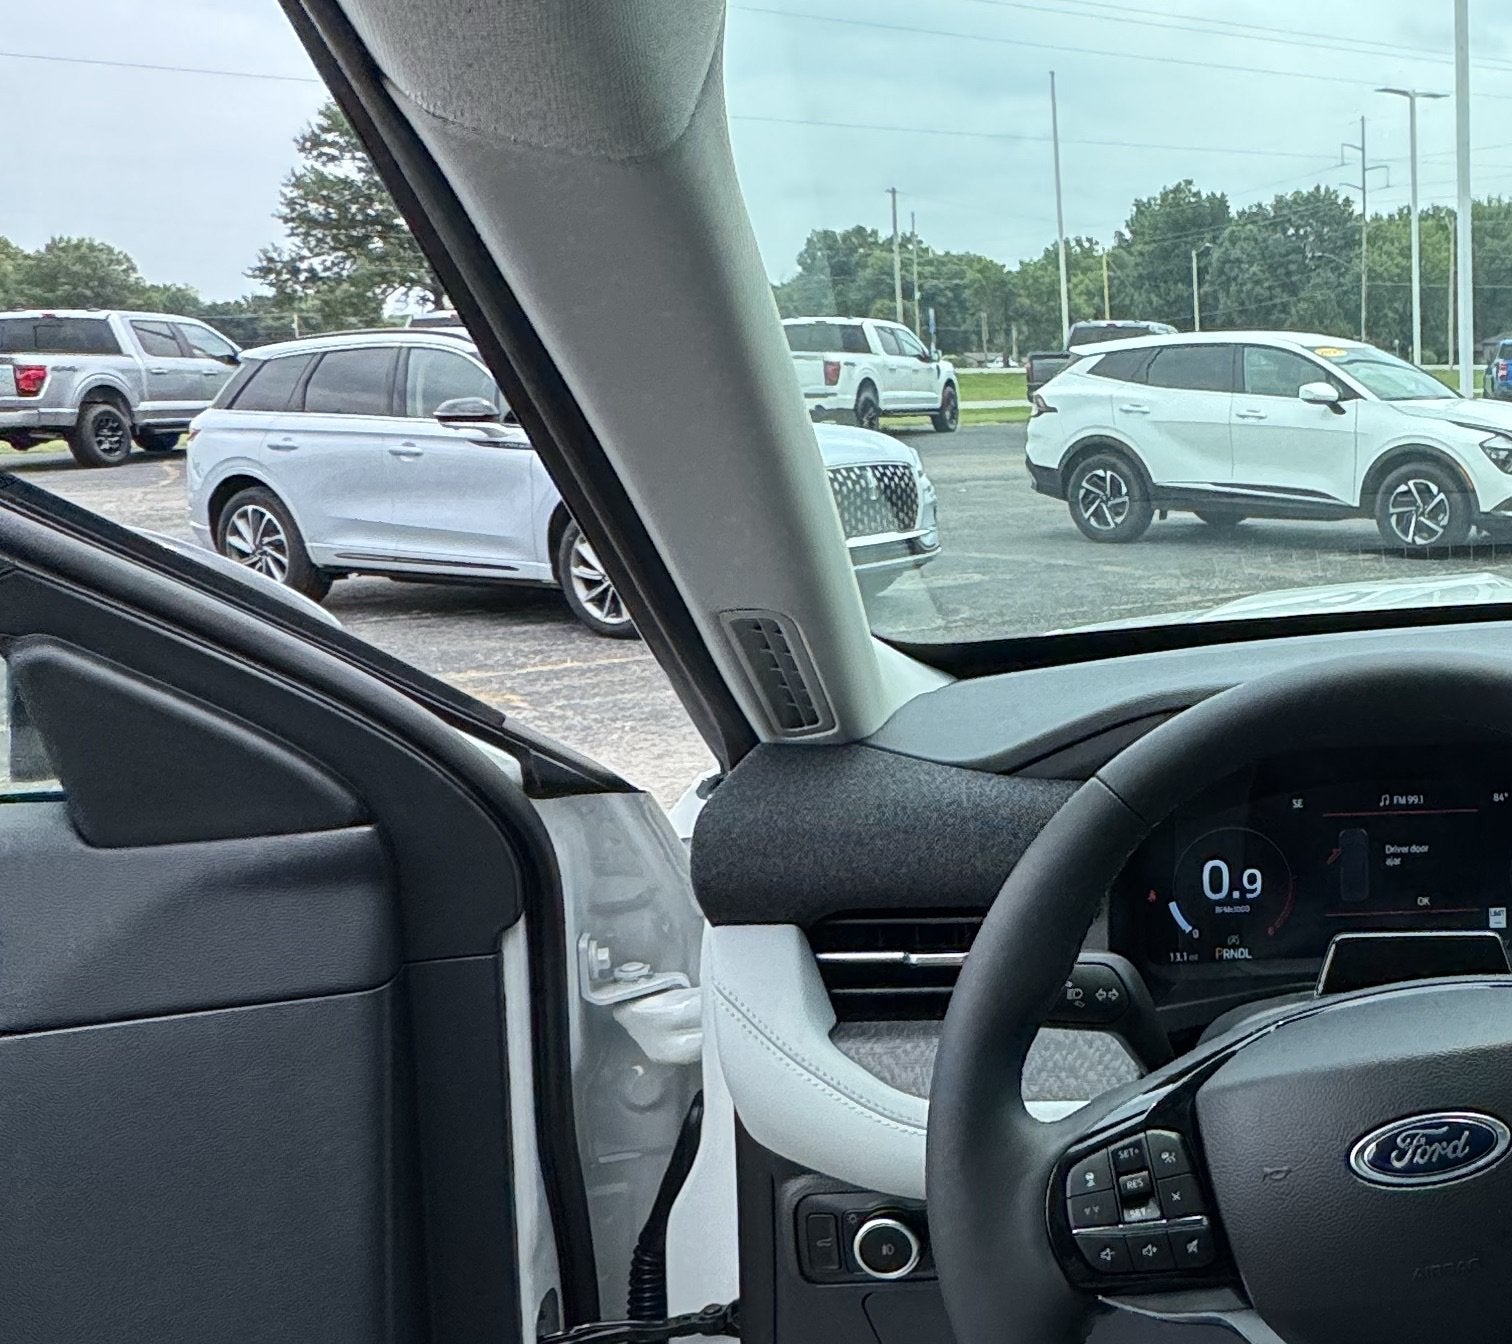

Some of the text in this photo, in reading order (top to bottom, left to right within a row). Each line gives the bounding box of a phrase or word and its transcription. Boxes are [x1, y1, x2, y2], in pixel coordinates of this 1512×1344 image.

[1292, 798, 1304, 809] SE
[1407, 795, 1424, 804] 99.1
[1385, 844, 1429, 854] Driver door
[1202, 859, 1263, 900] 0.9
[1417, 896, 1431, 906] OK
[1390, 1125, 1470, 1169] Ford
[1126, 1178, 1144, 1190] RES
